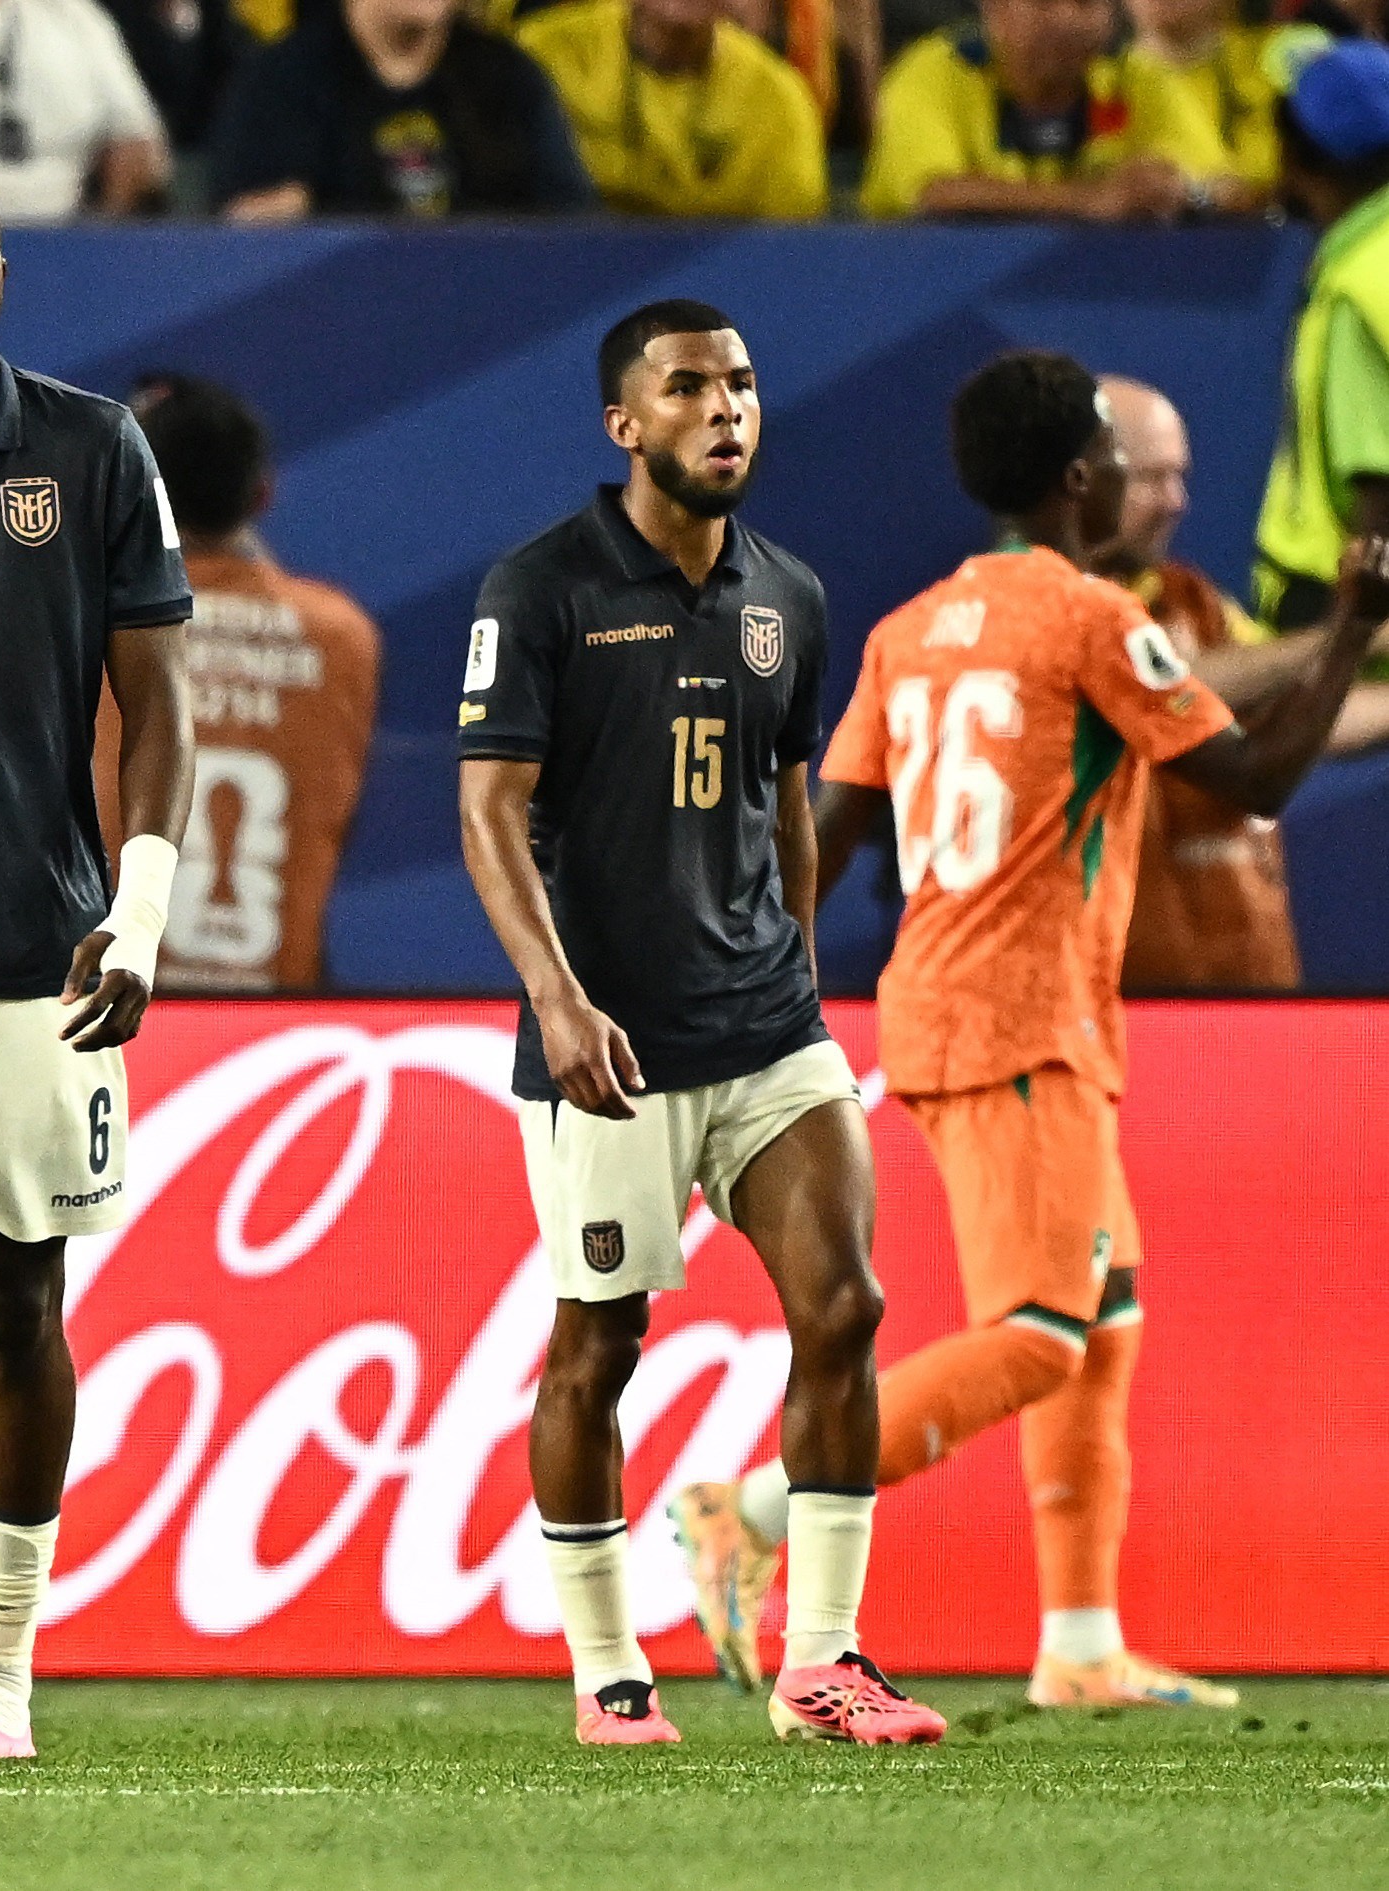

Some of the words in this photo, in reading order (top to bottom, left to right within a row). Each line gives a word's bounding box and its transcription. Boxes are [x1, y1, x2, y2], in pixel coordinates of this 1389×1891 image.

[585, 623, 675, 647] marathon
[671, 716, 727, 810] 15
[887, 670, 1022, 898] 26
[88, 1086, 111, 1175] 6
